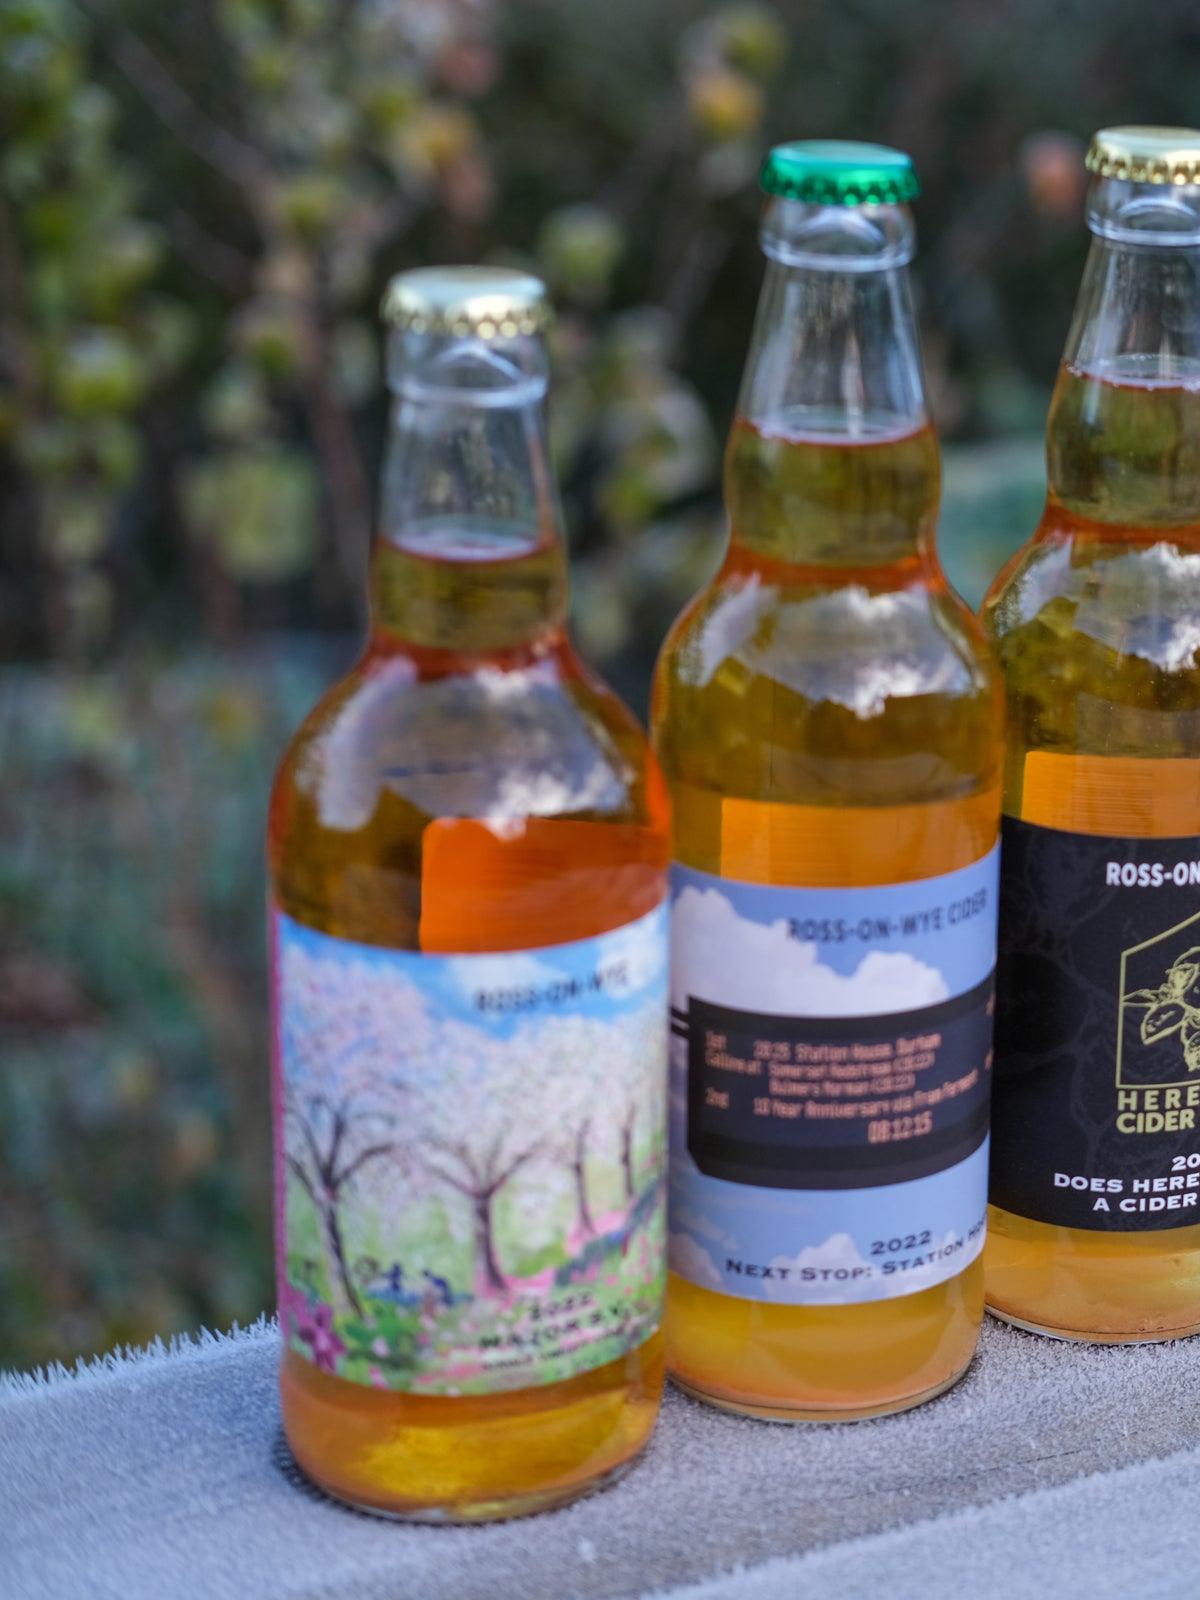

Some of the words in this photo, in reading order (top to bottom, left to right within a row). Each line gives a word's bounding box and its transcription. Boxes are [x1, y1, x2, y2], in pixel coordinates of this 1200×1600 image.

[786, 904, 944, 943] ROSS-ON-WYE
[947, 887, 987, 925] CIDER
[1116, 1108, 1195, 1134] CIDER
[1053, 1172, 1124, 1194] DOES
[1092, 1197, 1110, 1212] A
[1119, 1193, 1198, 1212] CIDER
[870, 1230, 932, 1255] 2022
